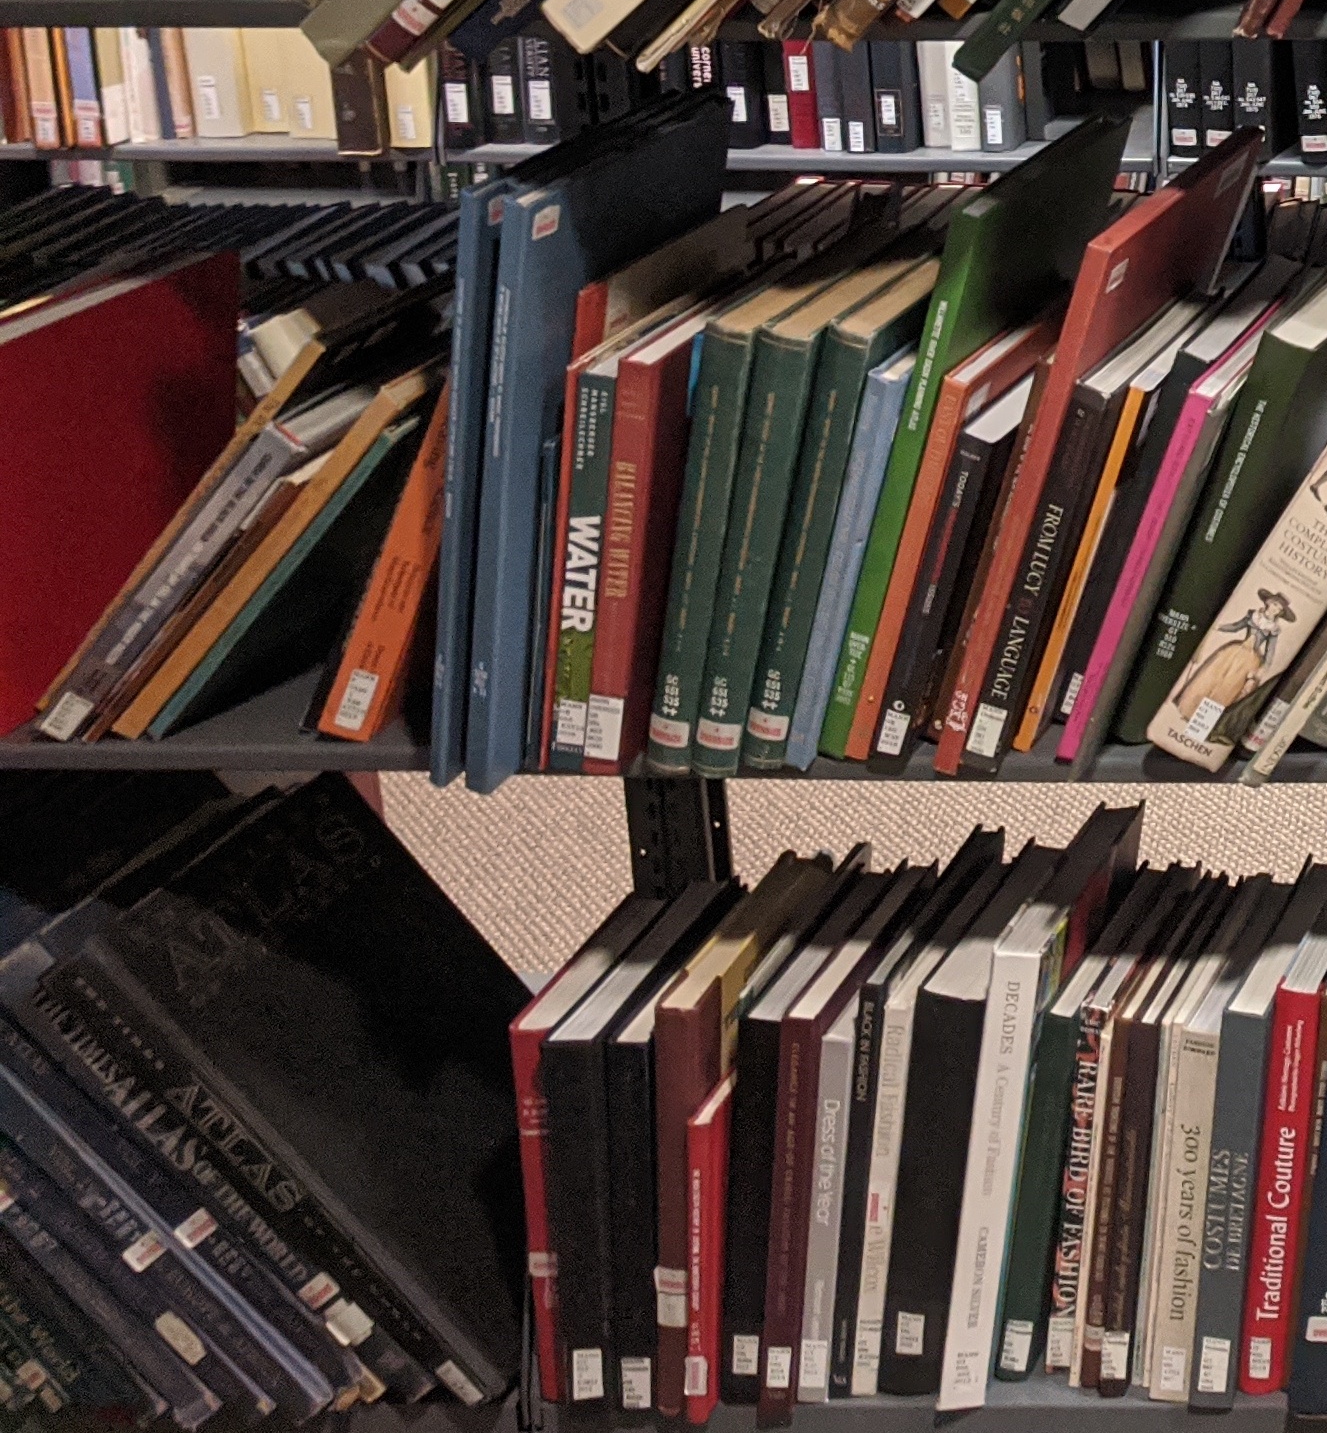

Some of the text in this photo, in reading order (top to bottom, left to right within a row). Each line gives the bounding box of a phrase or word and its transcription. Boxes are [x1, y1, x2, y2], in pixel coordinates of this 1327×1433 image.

[560, 514, 603, 634] WATER
[990, 502, 1065, 701] FROM LUCY LANGUAGE
[1166, 727, 1213, 758] TASCHEN
[998, 979, 1021, 1055] DECADES
[1054, 1058, 1099, 1319] RARE BIRD OF FASHION
[1168, 1123, 1201, 1322] 300 years of fashion
[1202, 1148, 1231, 1272] COSTUMES
[1255, 1125, 1298, 1322] Traditional Couture
